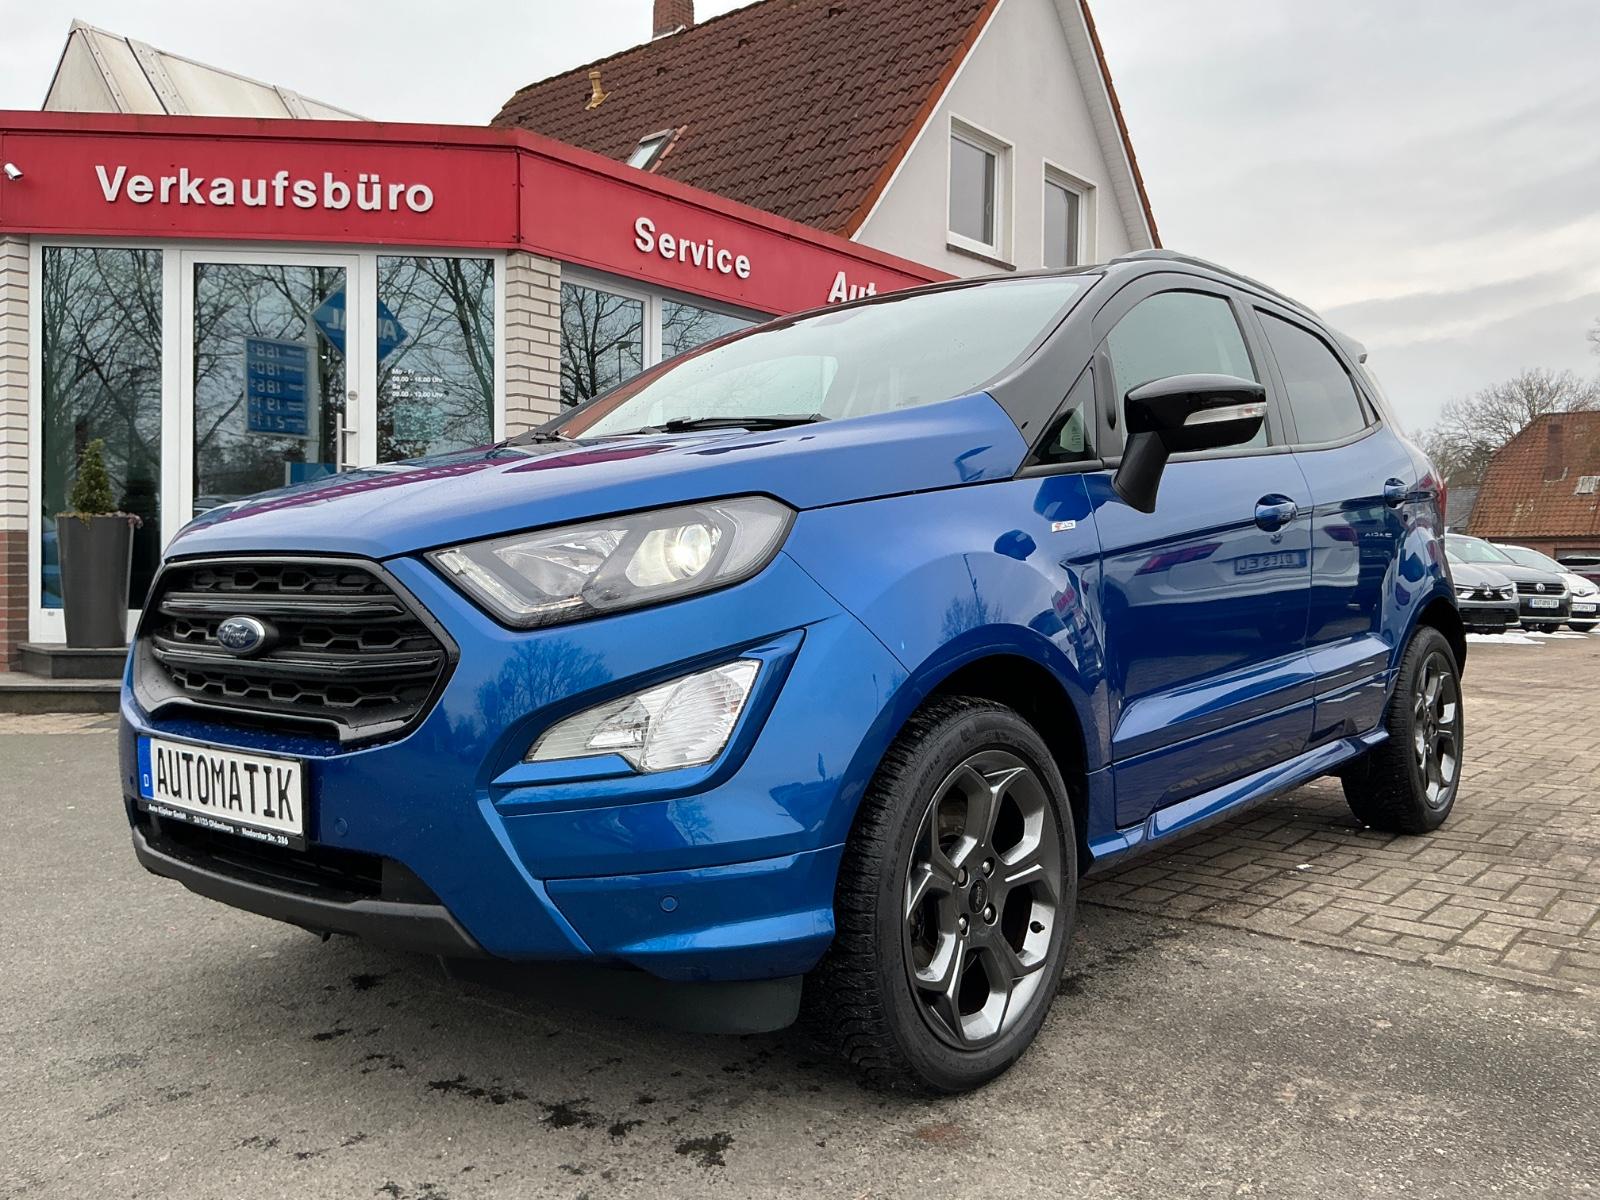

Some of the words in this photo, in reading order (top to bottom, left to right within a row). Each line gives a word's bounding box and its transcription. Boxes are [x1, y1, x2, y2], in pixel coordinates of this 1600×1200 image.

[95, 165, 434, 212] Verkaufsbüro
[634, 217, 751, 279] Service
[222, 622, 249, 641] Ford
[143, 773, 150, 787] D
[157, 747, 294, 822] AUTOMATIK
